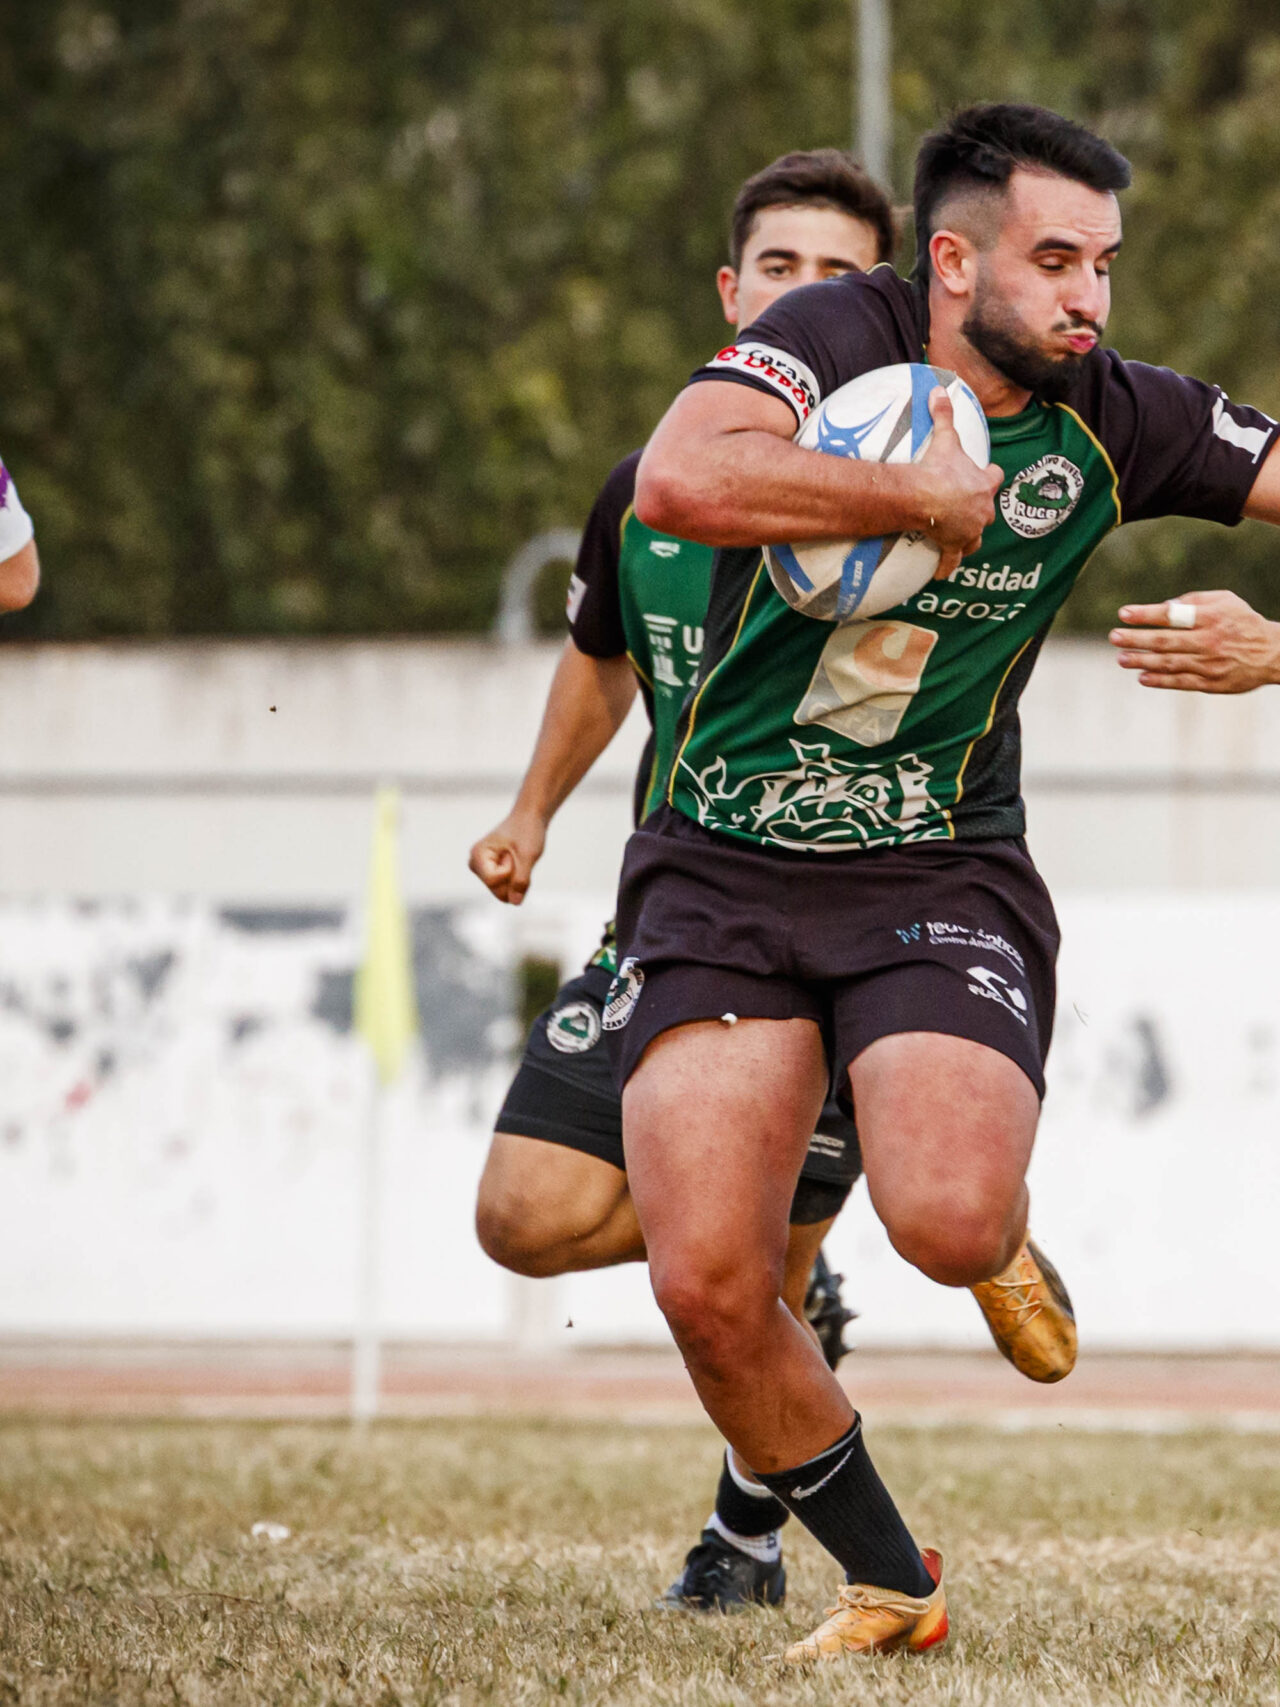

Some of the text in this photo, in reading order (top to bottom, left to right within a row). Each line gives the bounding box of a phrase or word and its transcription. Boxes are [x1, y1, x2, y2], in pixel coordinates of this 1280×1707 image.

[1015, 501, 1060, 520] RUGB
[948, 562, 1043, 591] rsidad
[902, 592, 1027, 622] agoz
